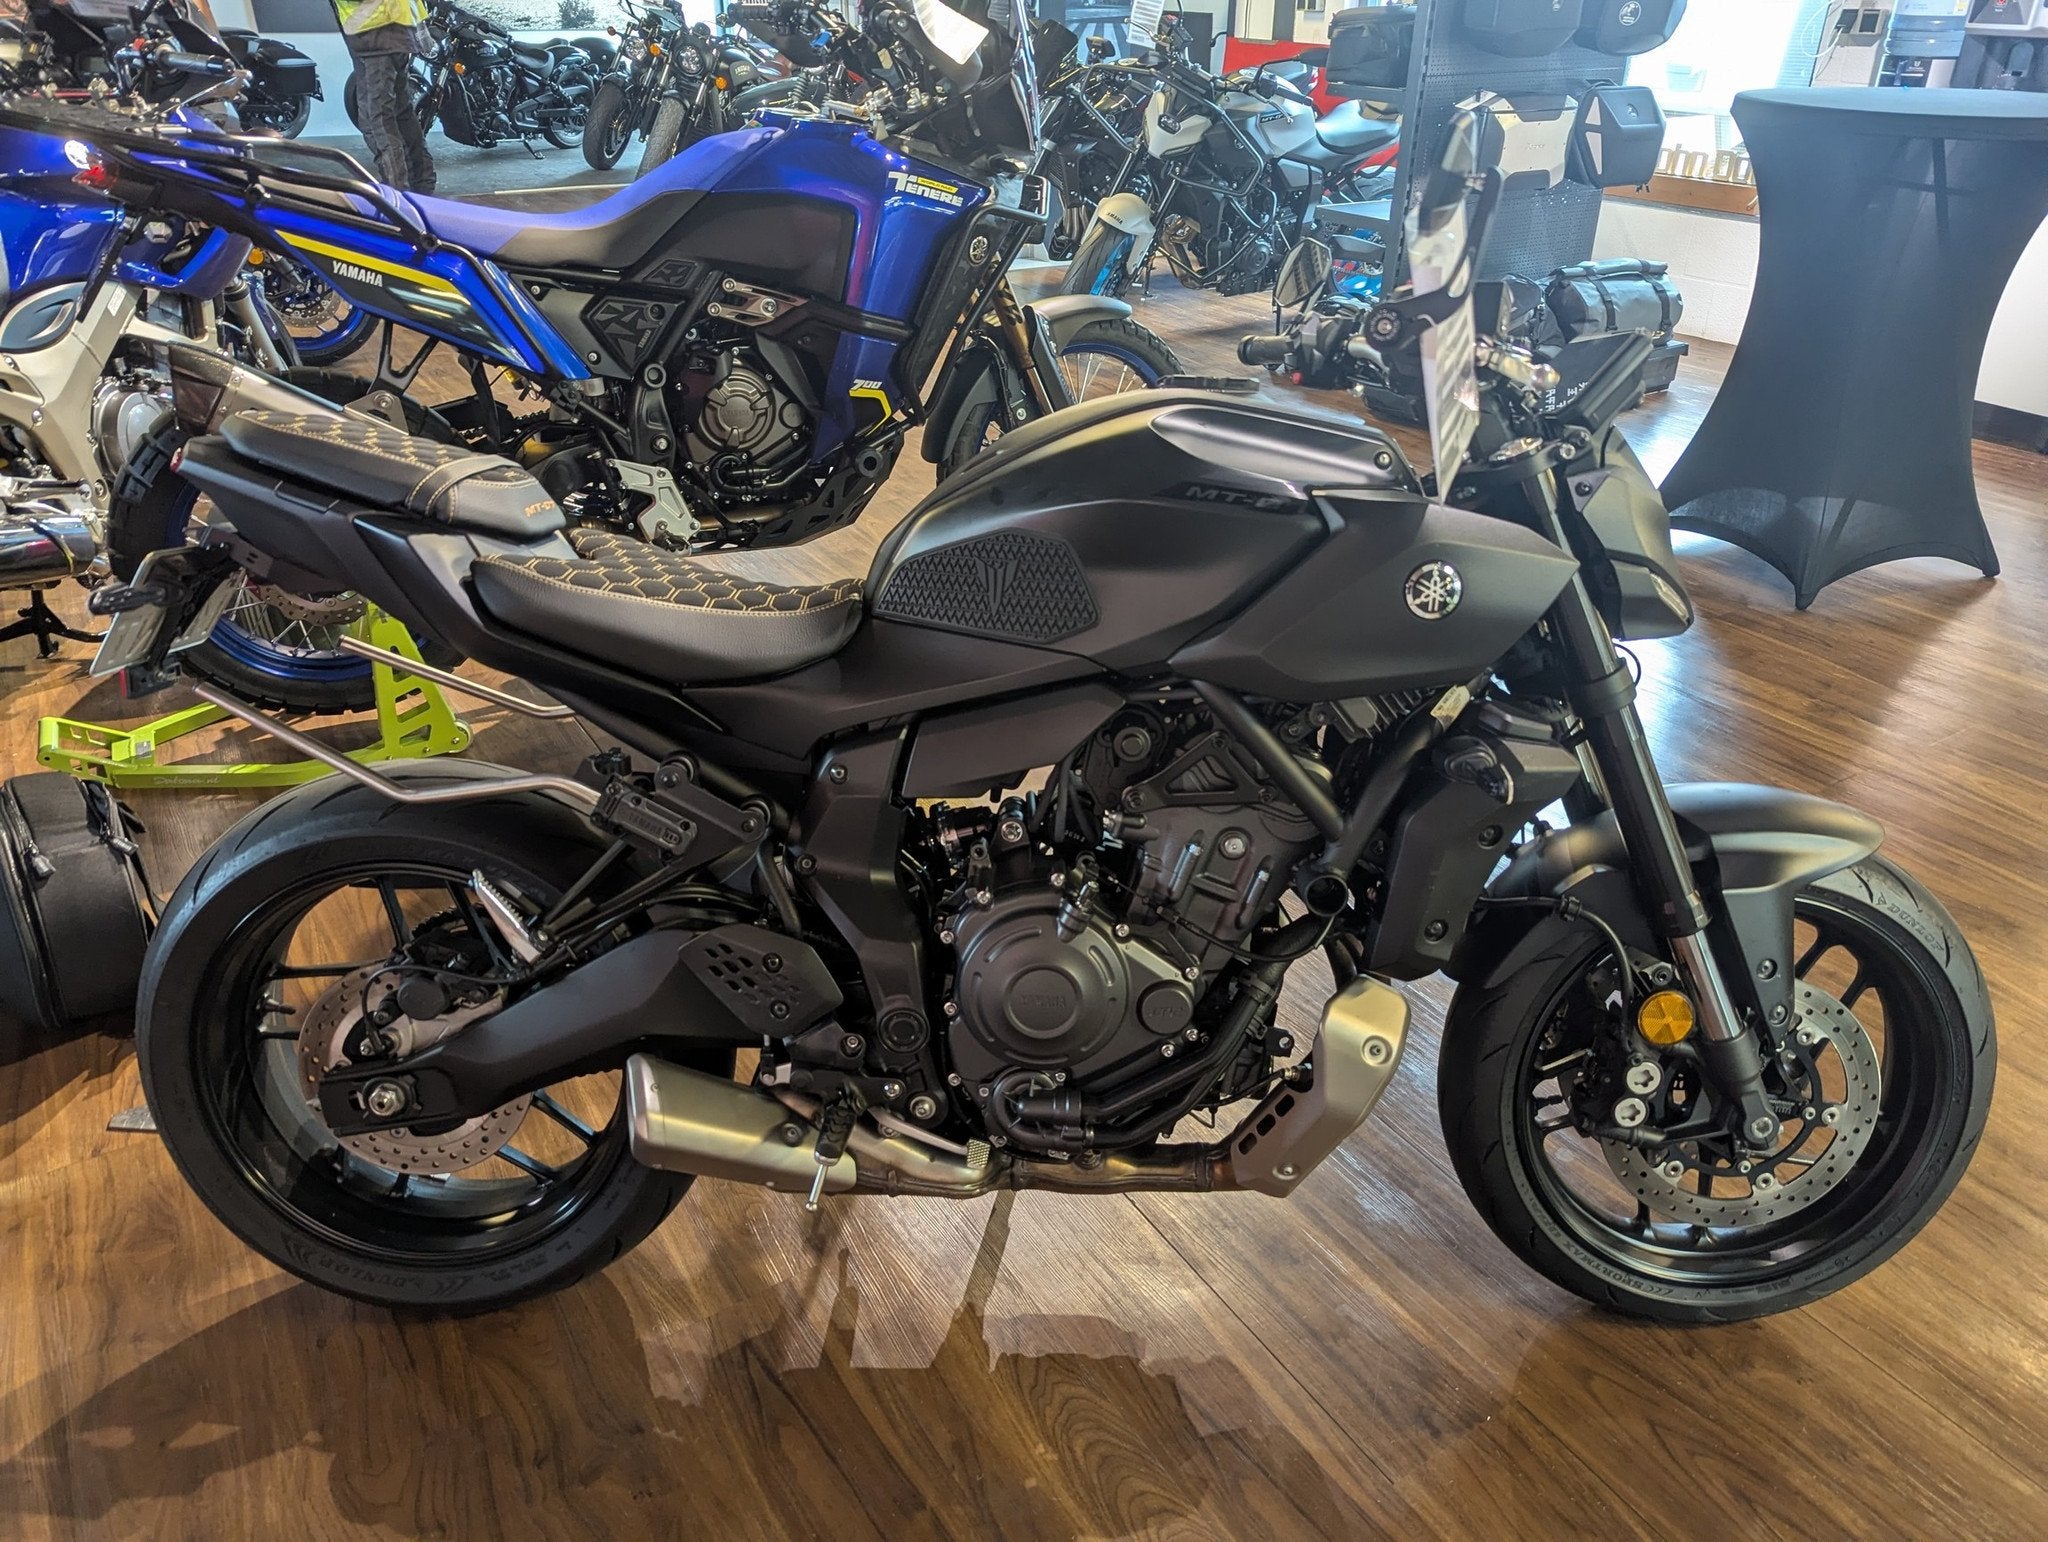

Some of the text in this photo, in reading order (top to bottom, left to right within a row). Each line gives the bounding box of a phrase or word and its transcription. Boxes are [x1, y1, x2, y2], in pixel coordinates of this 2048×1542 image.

[332, 260, 383, 288] YAMAHA
[850, 378, 883, 391] 700
[1563, 1241, 1644, 1291] SPORTMAX
